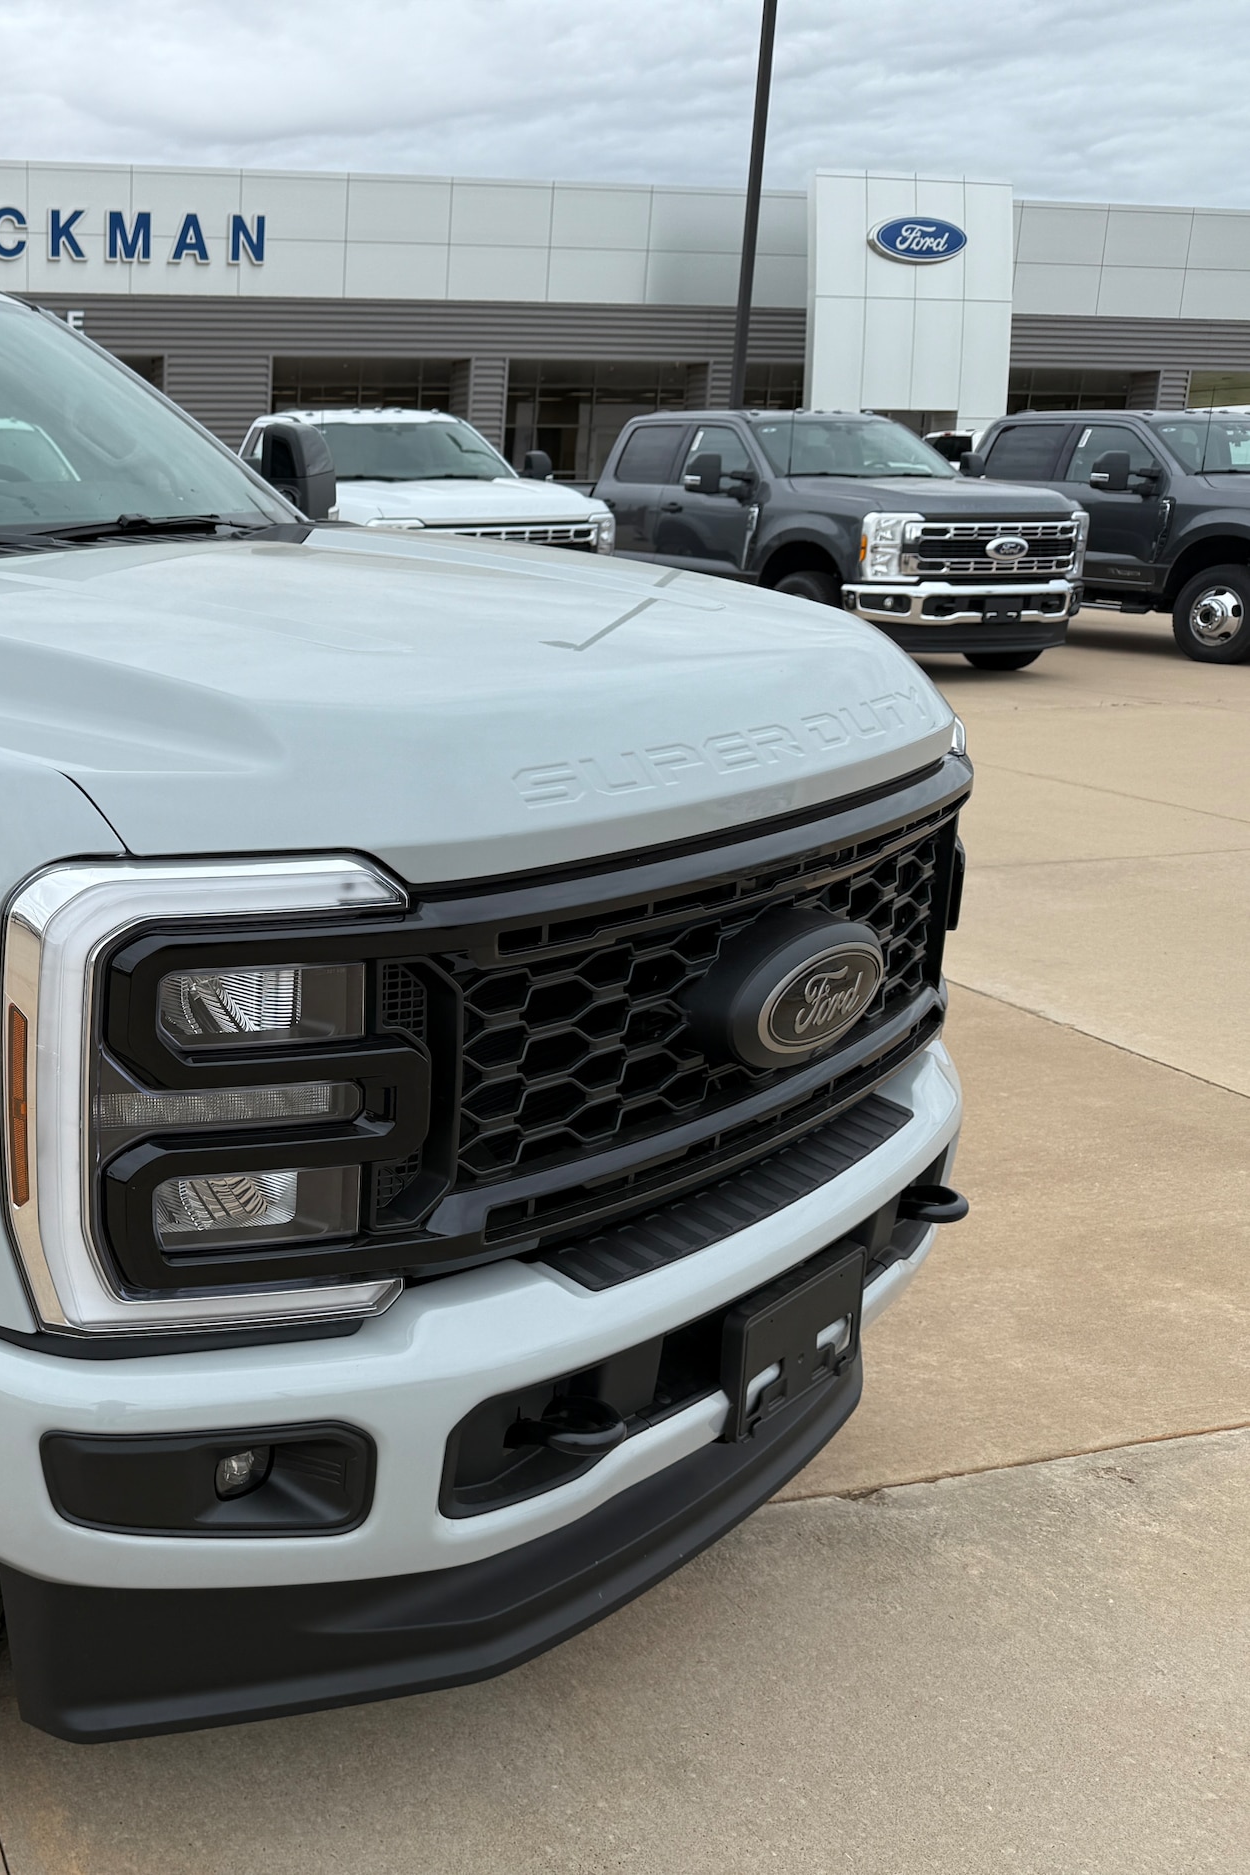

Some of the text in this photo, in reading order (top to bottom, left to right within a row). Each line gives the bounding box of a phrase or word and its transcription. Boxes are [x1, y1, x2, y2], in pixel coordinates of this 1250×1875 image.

[896, 224, 950, 252] Ford
[512, 685, 929, 810] SUPER DUTY
[794, 966, 864, 1034] Ford
